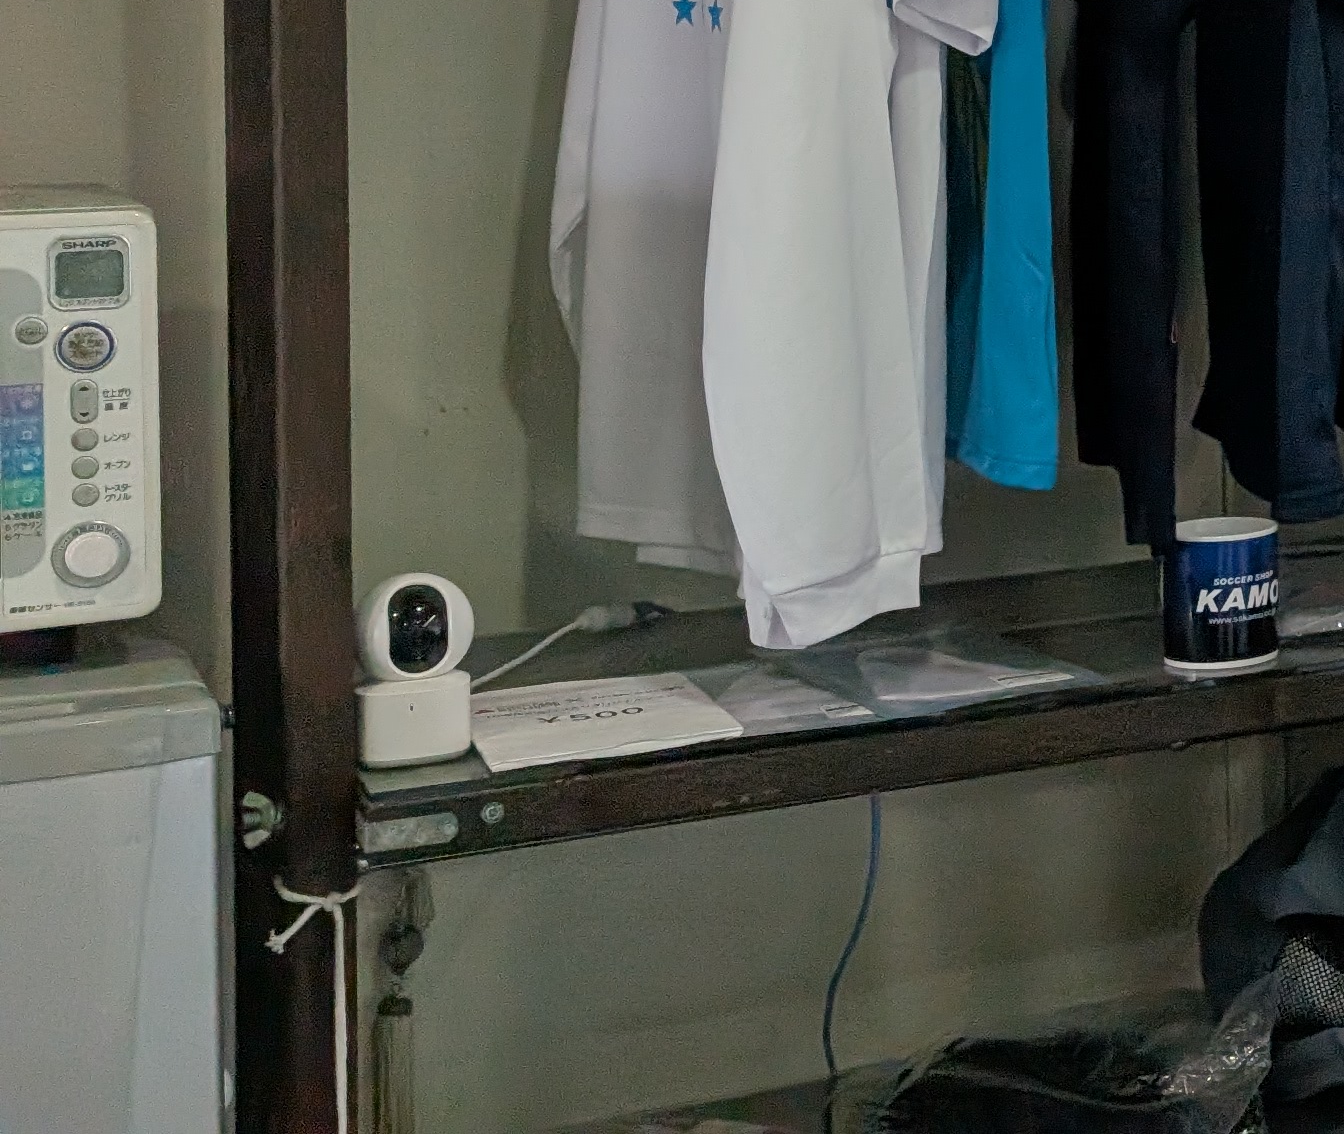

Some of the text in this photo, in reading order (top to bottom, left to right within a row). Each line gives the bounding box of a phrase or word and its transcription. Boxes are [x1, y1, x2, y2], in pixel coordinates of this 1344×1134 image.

[62, 239, 117, 250] SHARP
[1213, 574, 1254, 586] SOCCER
[1195, 578, 1279, 613] KAMO
